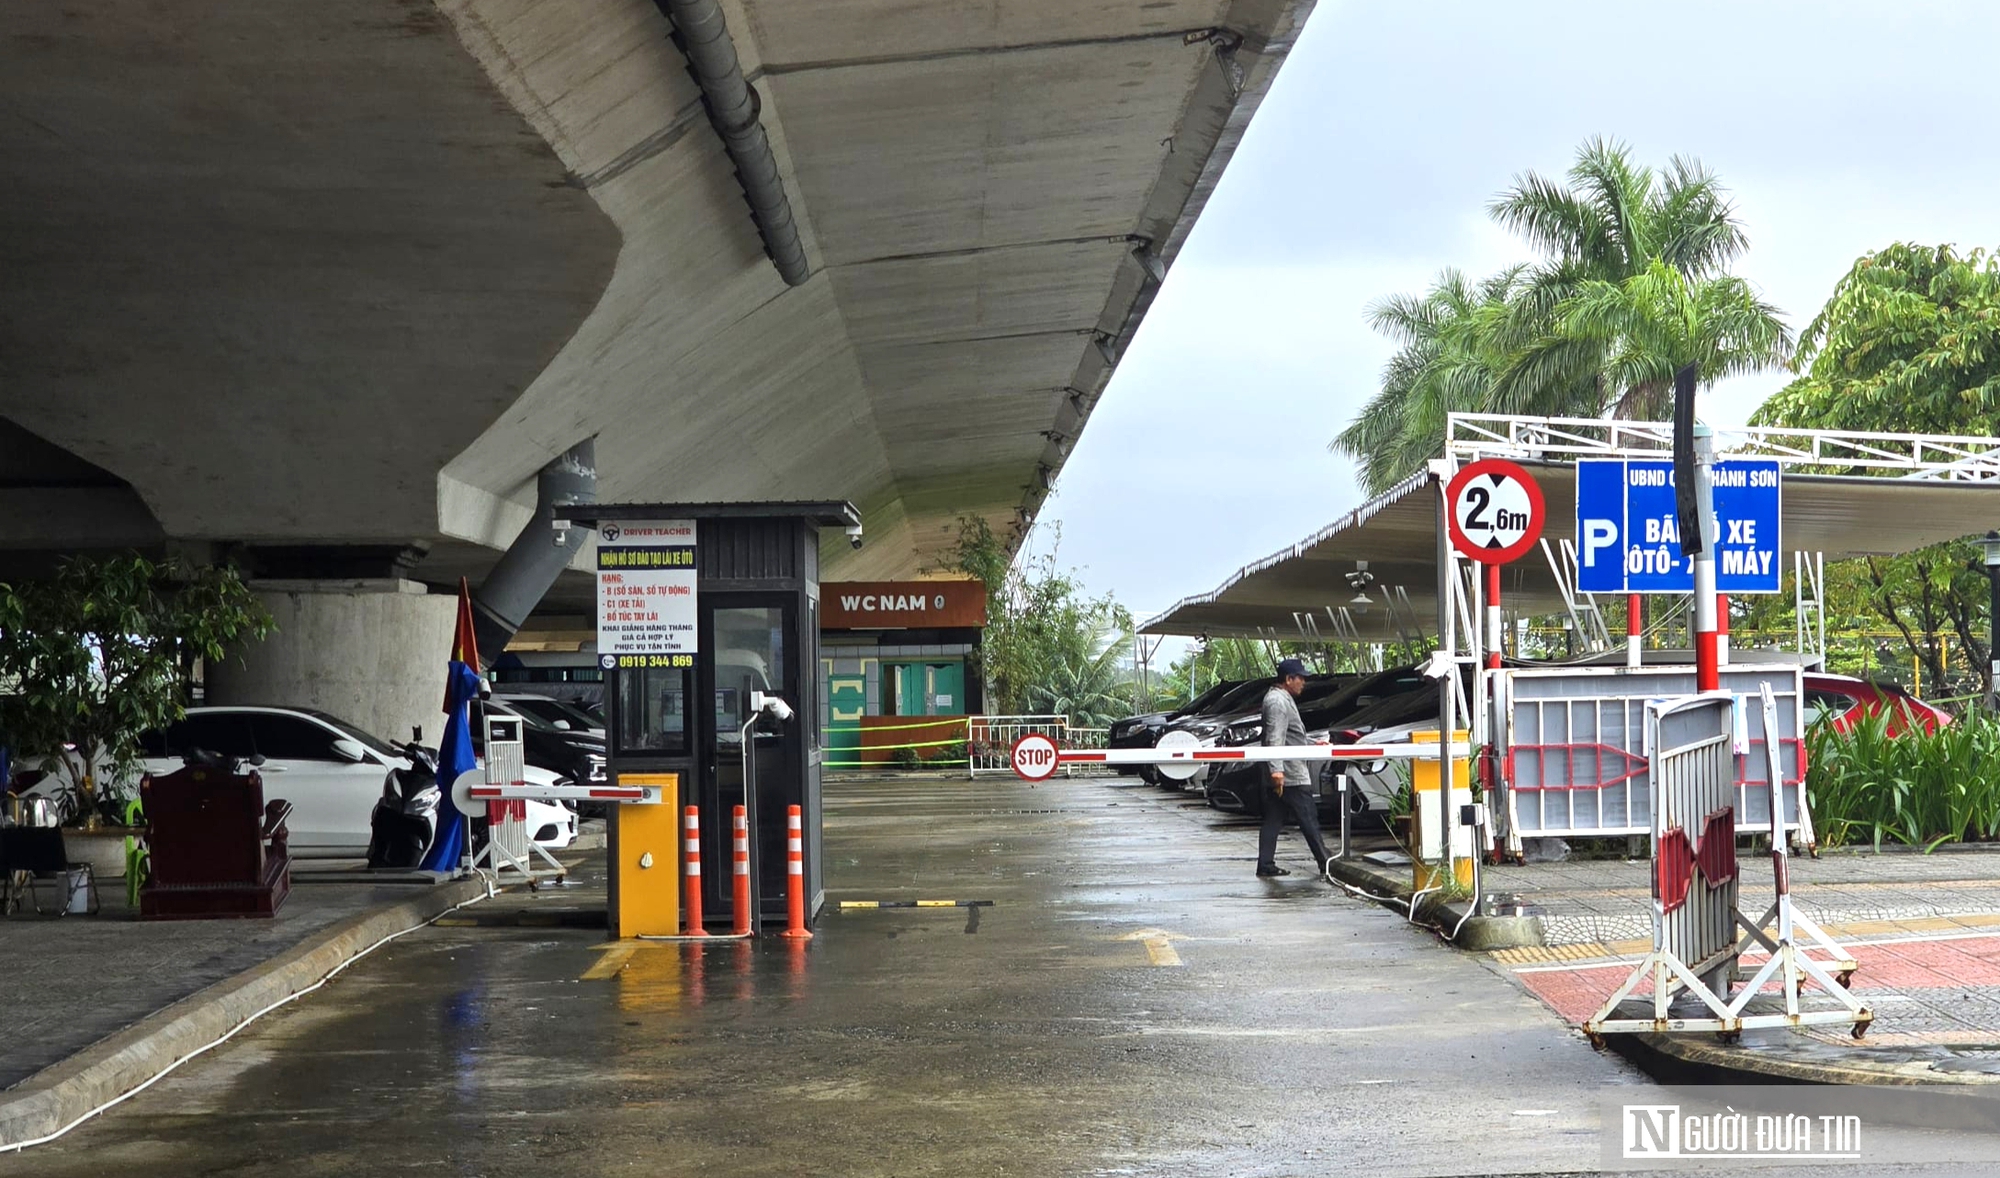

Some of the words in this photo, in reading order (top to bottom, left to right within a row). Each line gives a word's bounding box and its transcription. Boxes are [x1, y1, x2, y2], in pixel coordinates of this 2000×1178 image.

[1630, 470, 1666, 487] UBND
[1750, 468, 1777, 487] SƠN
[1465, 487, 1528, 533] 2,6m
[623, 528, 653, 536] DRIVER
[655, 527, 691, 535] TEACHER
[1727, 520, 1757, 544] XE
[1583, 519, 1619, 568] P
[601, 549, 618, 568] NHẬN
[628, 550, 637, 566] SƠ
[650, 551, 661, 568] TẠO
[662, 549, 672, 565] LÁI
[673, 551, 681, 565] XE
[1722, 546, 1773, 575] MÁY
[658, 585, 667, 597] TỰ
[606, 599, 616, 608] C1
[618, 599, 630, 608] (XE
[840, 594, 877, 611] WC
[880, 594, 927, 611] NAM
[619, 611, 632, 621] TÚC
[634, 612, 646, 621] TAY
[647, 611, 658, 621] LÁI
[621, 633, 635, 641] GIÁ
[636, 633, 647, 641] CẢ
[648, 633, 663, 641] HỢP
[614, 643, 635, 651] PHỤC
[636, 643, 646, 651] VỤ
[648, 642, 662, 651] TẬN
[664, 642, 682, 650] TÌNH
[619, 655, 647, 668] 0919
[649, 655, 670, 667] 344
[672, 655, 693, 667] 869
[1018, 749, 1053, 766] STOP
